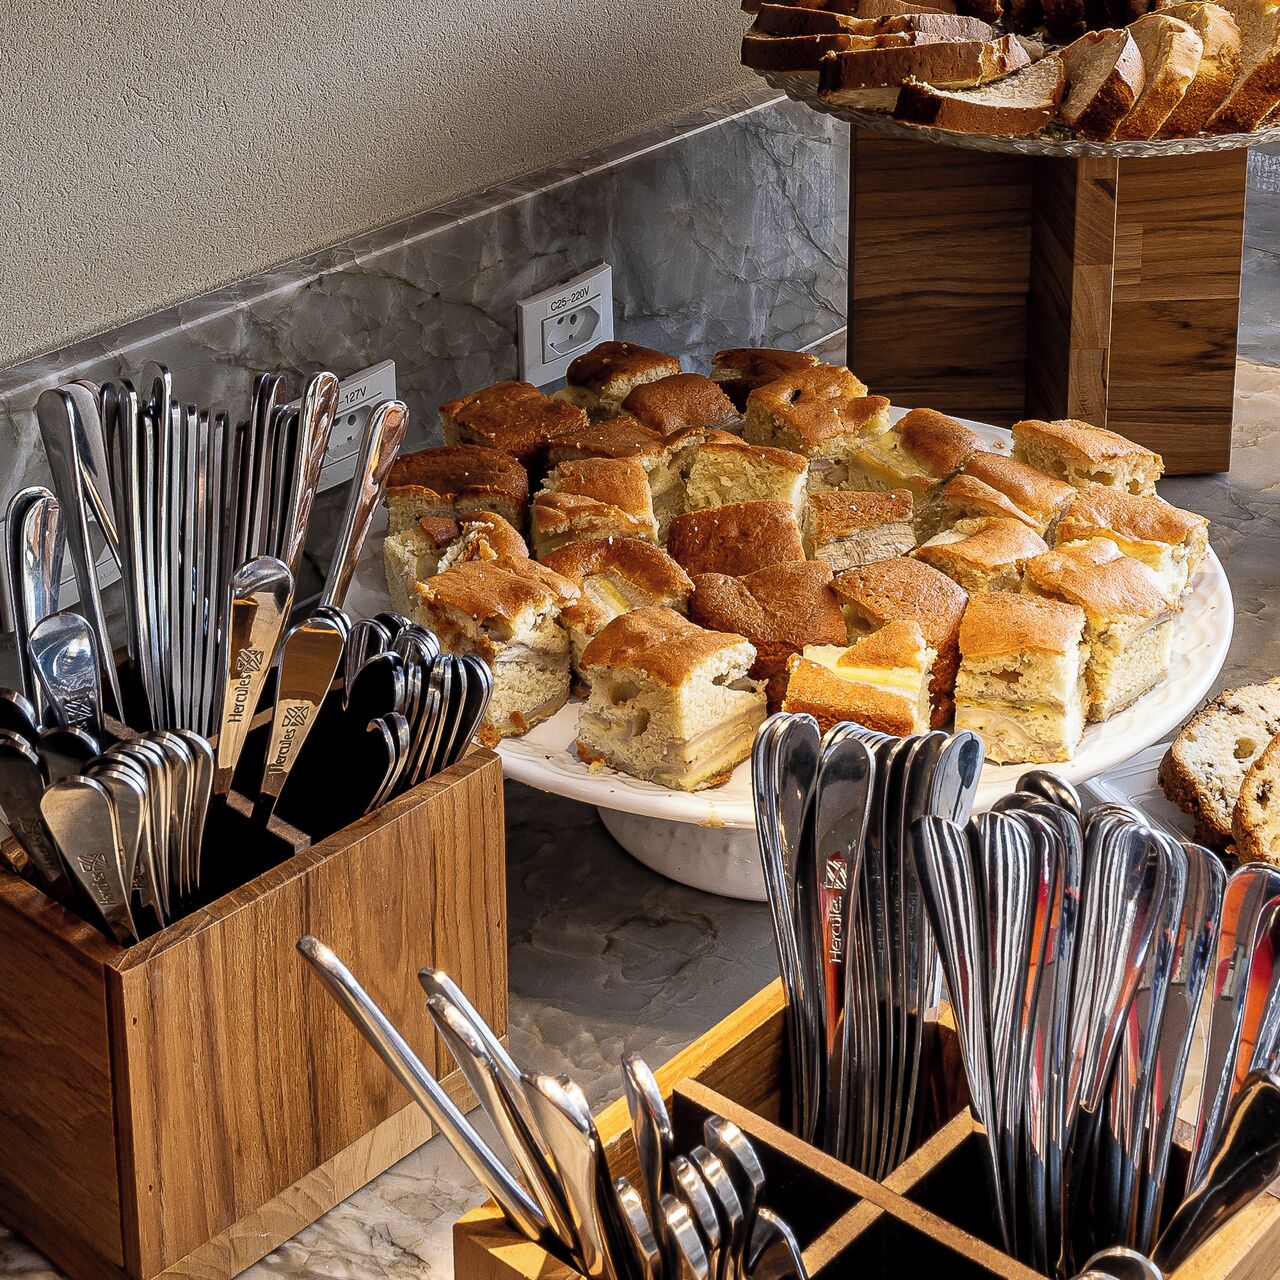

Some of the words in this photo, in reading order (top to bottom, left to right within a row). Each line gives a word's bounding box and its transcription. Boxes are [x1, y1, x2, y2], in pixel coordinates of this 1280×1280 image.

[550, 285, 591, 312] C25-220V
[338, 386, 367, 406] -127V
[227, 672, 252, 724] Hercules
[269, 728, 296, 775] Hercules
[829, 895, 842, 963] Hercules
